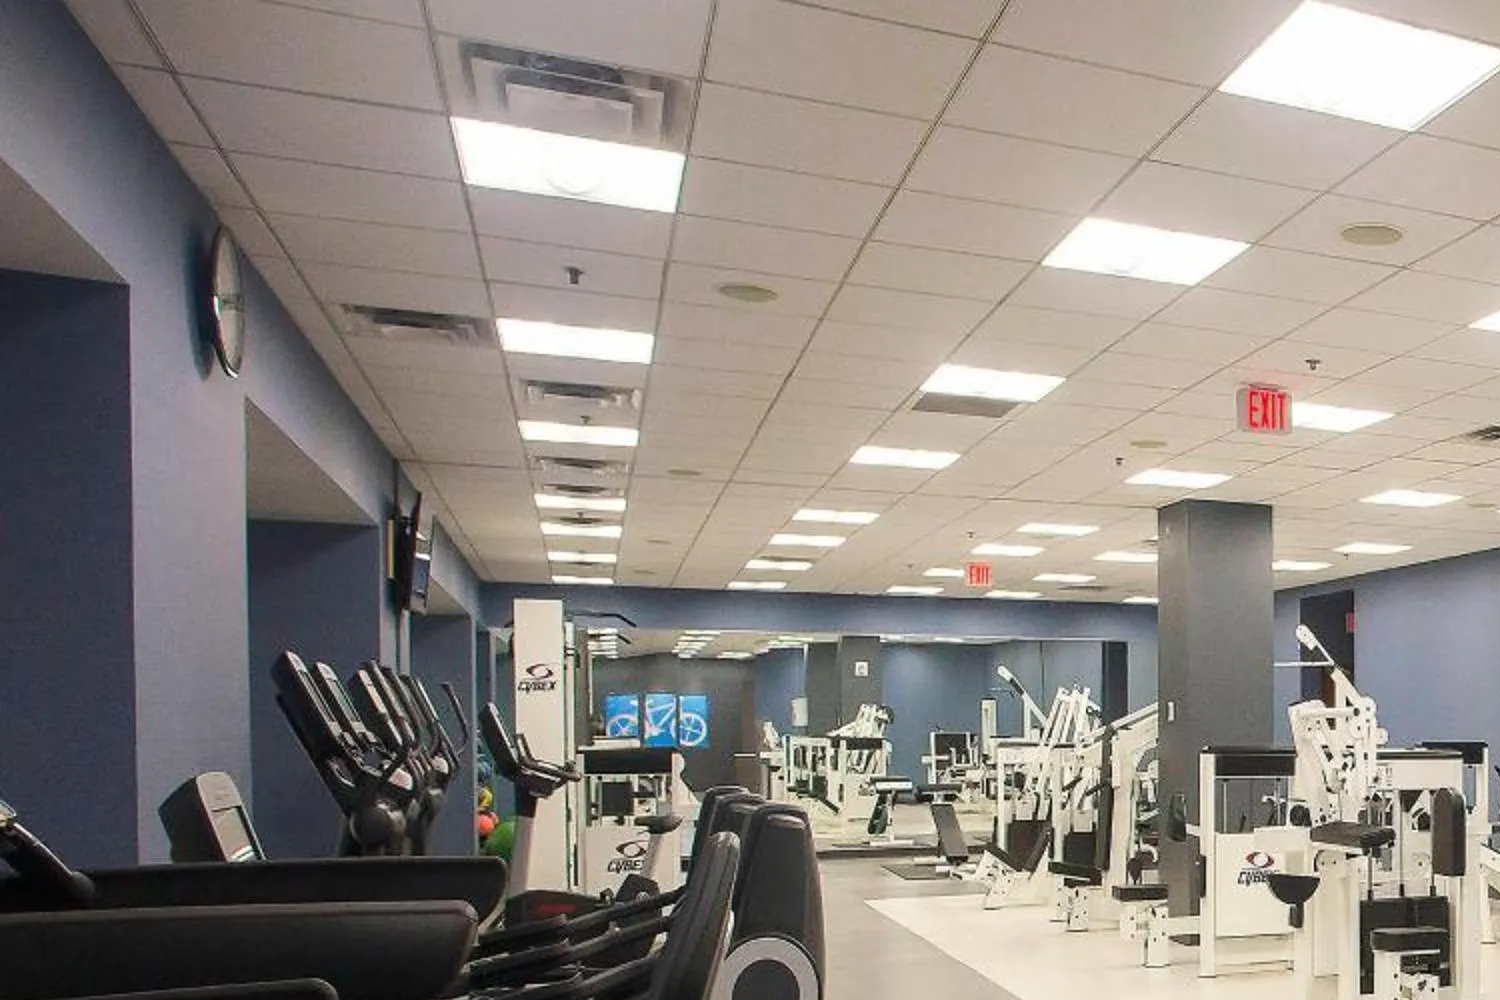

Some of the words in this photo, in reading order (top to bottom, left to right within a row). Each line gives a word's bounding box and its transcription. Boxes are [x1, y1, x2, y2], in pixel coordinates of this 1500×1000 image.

[1249, 391, 1286, 430] EXIT
[969, 565, 989, 585] EXIT
[607, 859, 645, 874] CYBE
